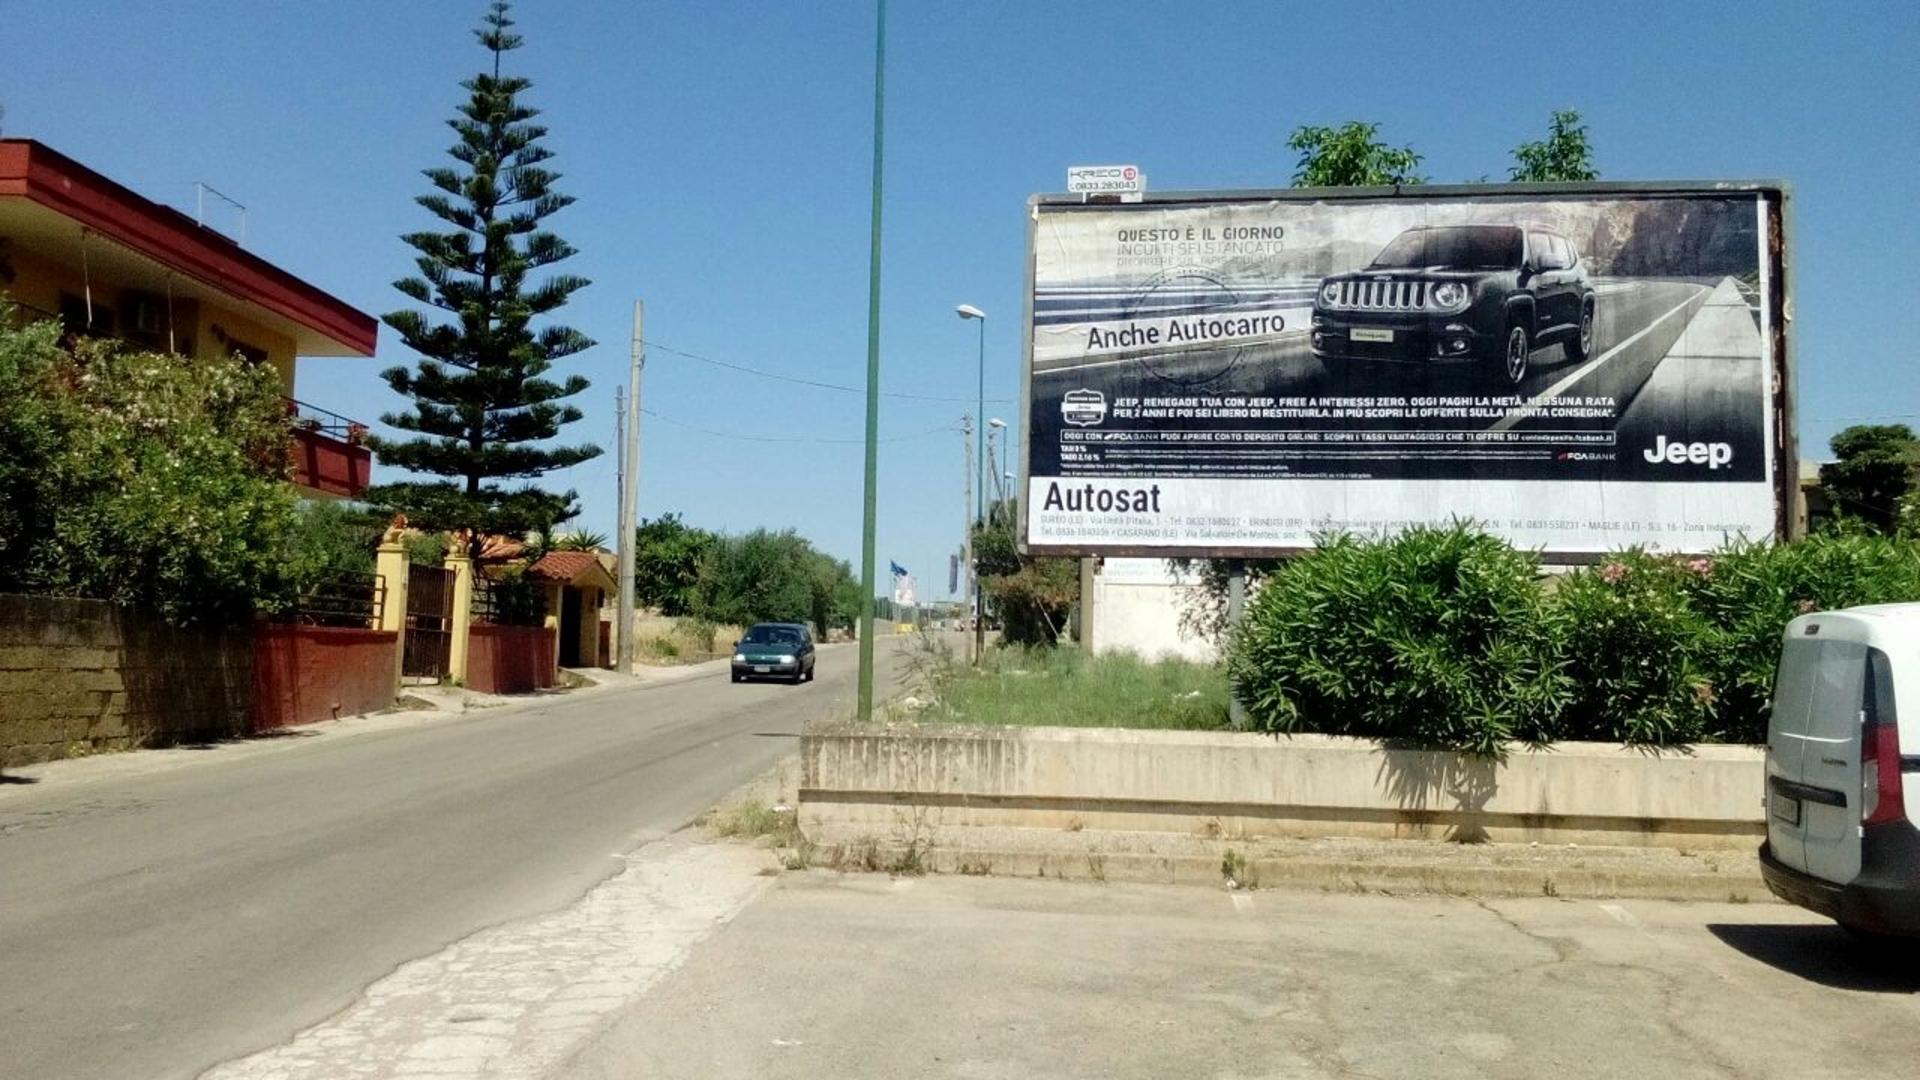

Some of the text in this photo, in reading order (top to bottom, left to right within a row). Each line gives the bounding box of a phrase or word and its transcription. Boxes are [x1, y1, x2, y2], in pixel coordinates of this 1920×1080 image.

[1118, 225, 1284, 242] QUESTO È IL GIORNO
[1087, 314, 1286, 350] Anche Autocarro
[1143, 397, 1199, 407] RENEGADE
[1201, 397, 1222, 407] TUA
[1224, 397, 1246, 407] CON
[1279, 397, 1307, 407] FREE
[1309, 397, 1317, 407] A
[1319, 397, 1375, 407] INTERESSI
[1411, 397, 1437, 407] OGGI
[1439, 396, 1473, 407] PAGHI
[1475, 396, 1490, 406] LA
[1527, 396, 1583, 407] NESSUNA
[1585, 396, 1616, 406] RATA
[1113, 408, 1133, 419] PER
[1142, 408, 1167, 418] ANNI
[1168, 408, 1175, 418] E
[1176, 408, 1194, 418] POI
[1195, 408, 1211, 418] SEI
[1212, 408, 1249, 418] LIBERO
[1250, 408, 1261, 418] DI
[1333, 408, 1344, 418] IN
[1364, 408, 1403, 418] SCOPRI
[1405, 408, 1418, 418] LE
[1420, 408, 1468, 418] OFFERTE
[1469, 408, 1504, 418] SULLA
[1505, 407, 1549, 418] PRONTA
[1085, 433, 1103, 441] CON
[1182, 433, 1213, 441] APRIRE
[1243, 433, 1286, 441] DEPOSITO
[1323, 433, 1355, 442] SCOPRI
[1361, 433, 1387, 441] TASSI
[1387, 433, 1444, 441] VANTAGGIOSI
[1445, 432, 1464, 441] CHE
[1475, 432, 1505, 441] OFFRE
[1506, 432, 1520, 441] SU
[1643, 434, 1732, 470] Jeep
[1043, 481, 1161, 513] Autosat
[1116, 527, 1160, 538] CASARANO
